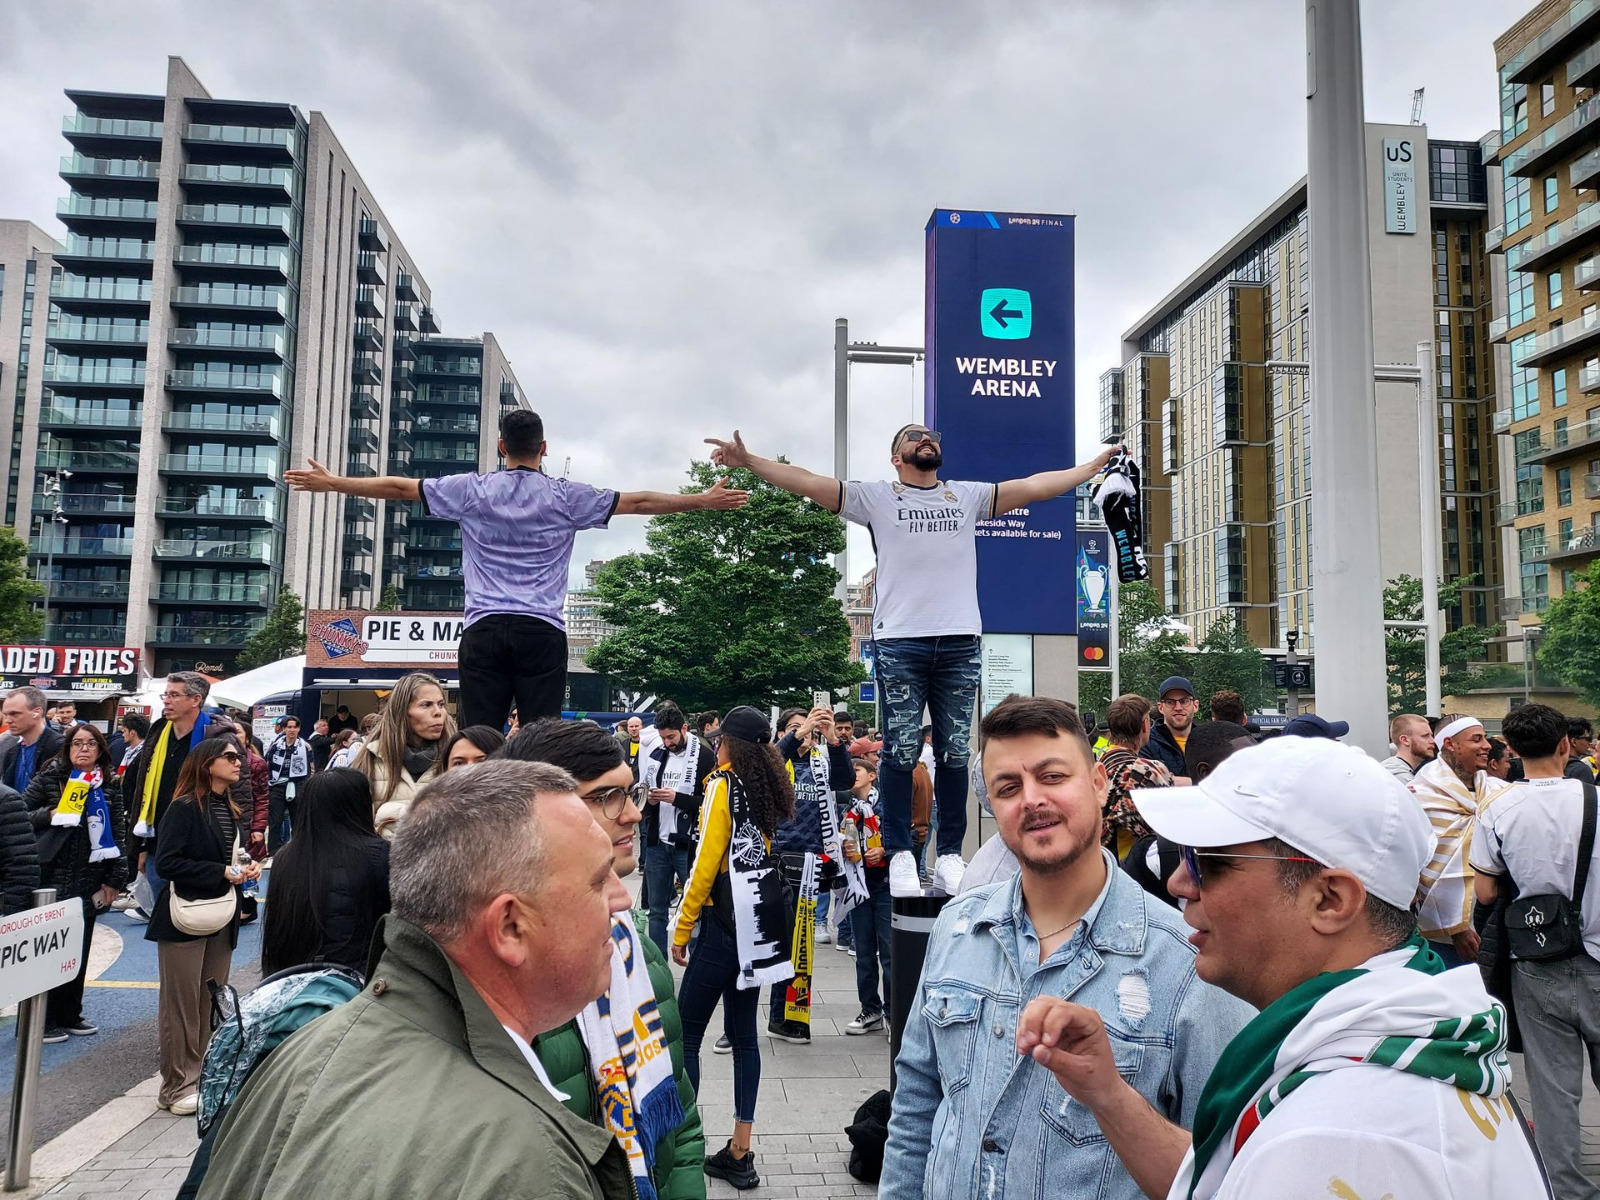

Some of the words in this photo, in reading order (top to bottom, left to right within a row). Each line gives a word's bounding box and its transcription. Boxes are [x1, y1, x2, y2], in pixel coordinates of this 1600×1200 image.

[1396, 183, 1407, 231] WEMBLEY
[1041, 219, 1063, 227] FINAL
[955, 356, 1057, 377] WEMBLEY
[970, 378, 1042, 398] ARENA
[898, 507, 965, 521] Emirates
[909, 521, 924, 533] FLY
[927, 520, 958, 532] BETTER
[1007, 520, 1026, 529] Way
[991, 530, 1027, 538] available
[1029, 530, 1040, 538] for
[1042, 531, 1062, 540] sale)
[311, 622, 369, 655] CHUNKY'S
[368, 620, 401, 641] PIE
[408, 621, 424, 641] &
[62, 648, 135, 675] FRIES
[71, 682, 94, 690] VEGAN
[95, 682, 122, 691] OPTIONS
[684, 767, 692, 783] JUNE
[33, 913, 43, 925] OF
[44, 907, 66, 921] BRENT
[0, 939, 29, 969] PIC
[33, 926, 70, 958] WAY
[60, 958, 76, 973] HA9
